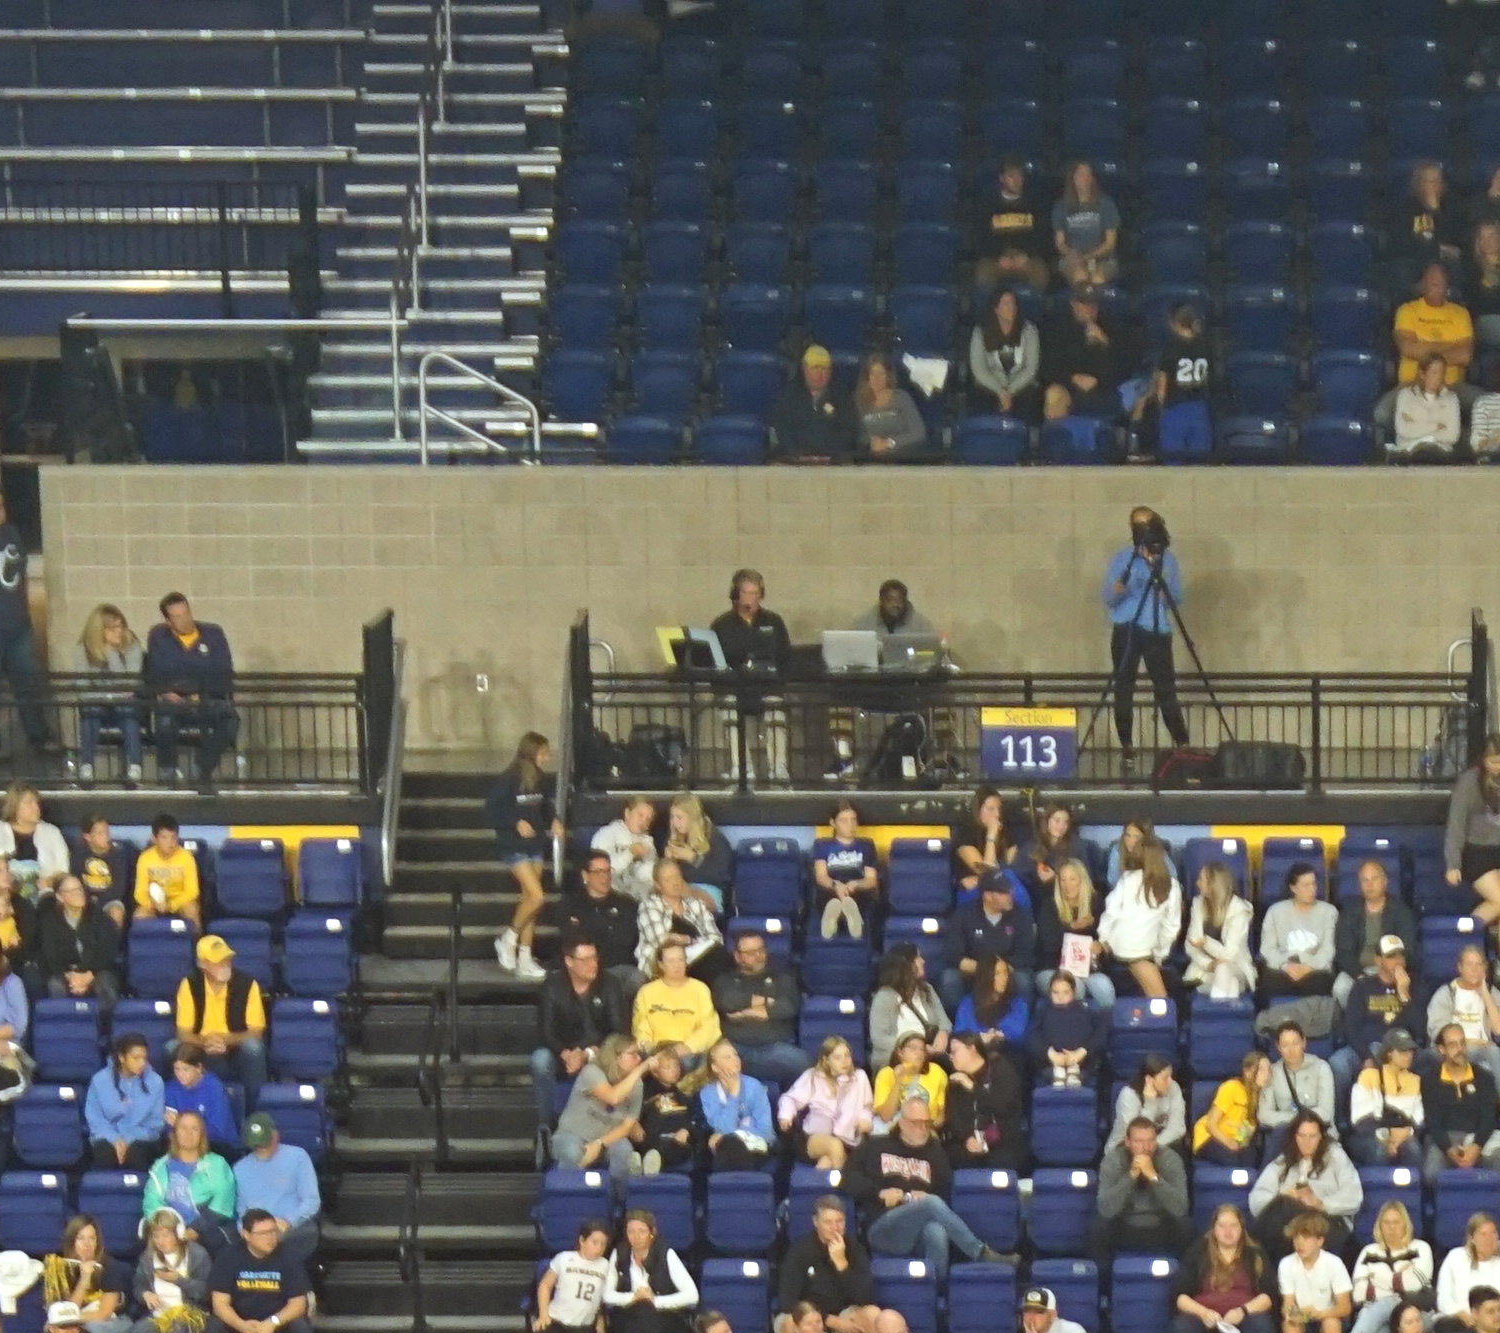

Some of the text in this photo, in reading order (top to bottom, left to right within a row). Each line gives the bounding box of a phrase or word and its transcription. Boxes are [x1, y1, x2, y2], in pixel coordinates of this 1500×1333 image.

[1176, 358, 1208, 382] 20
[1005, 711, 1053, 724] Section
[1001, 735, 1058, 768] 113
[574, 1281, 596, 1302] 12
